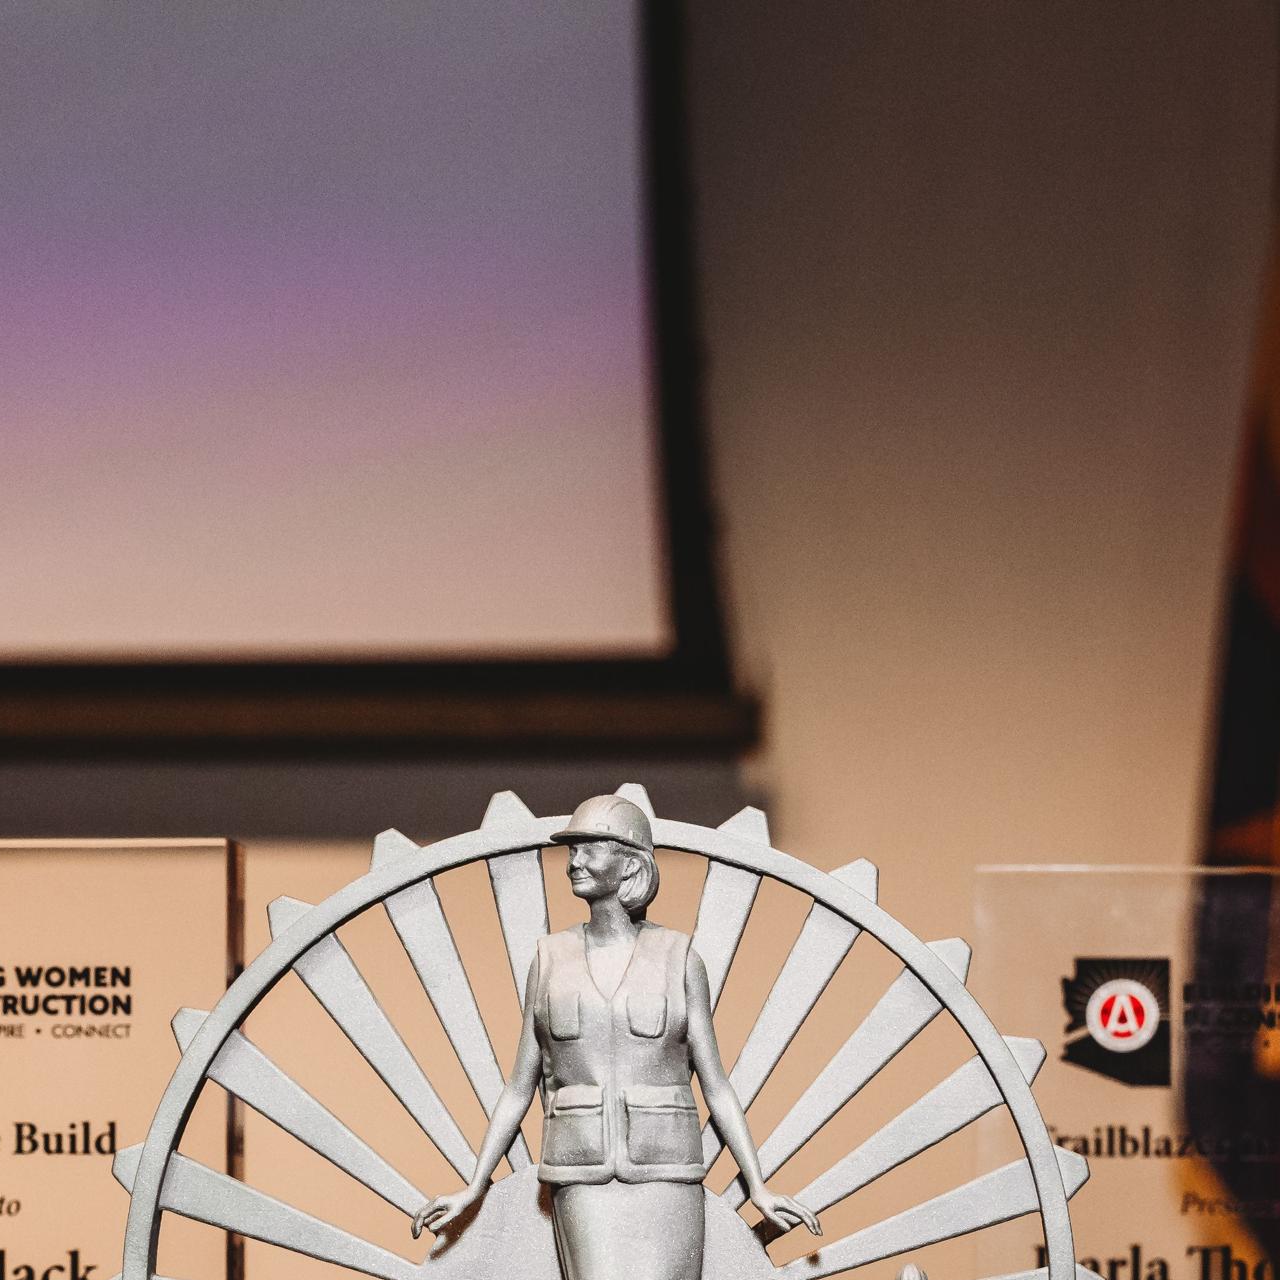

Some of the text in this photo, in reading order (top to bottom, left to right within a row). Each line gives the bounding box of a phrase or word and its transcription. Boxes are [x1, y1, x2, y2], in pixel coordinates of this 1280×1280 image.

[14, 966, 131, 988] WOMEN
[51, 1024, 131, 1039] CONNECT
[14, 1121, 117, 1155] Build
